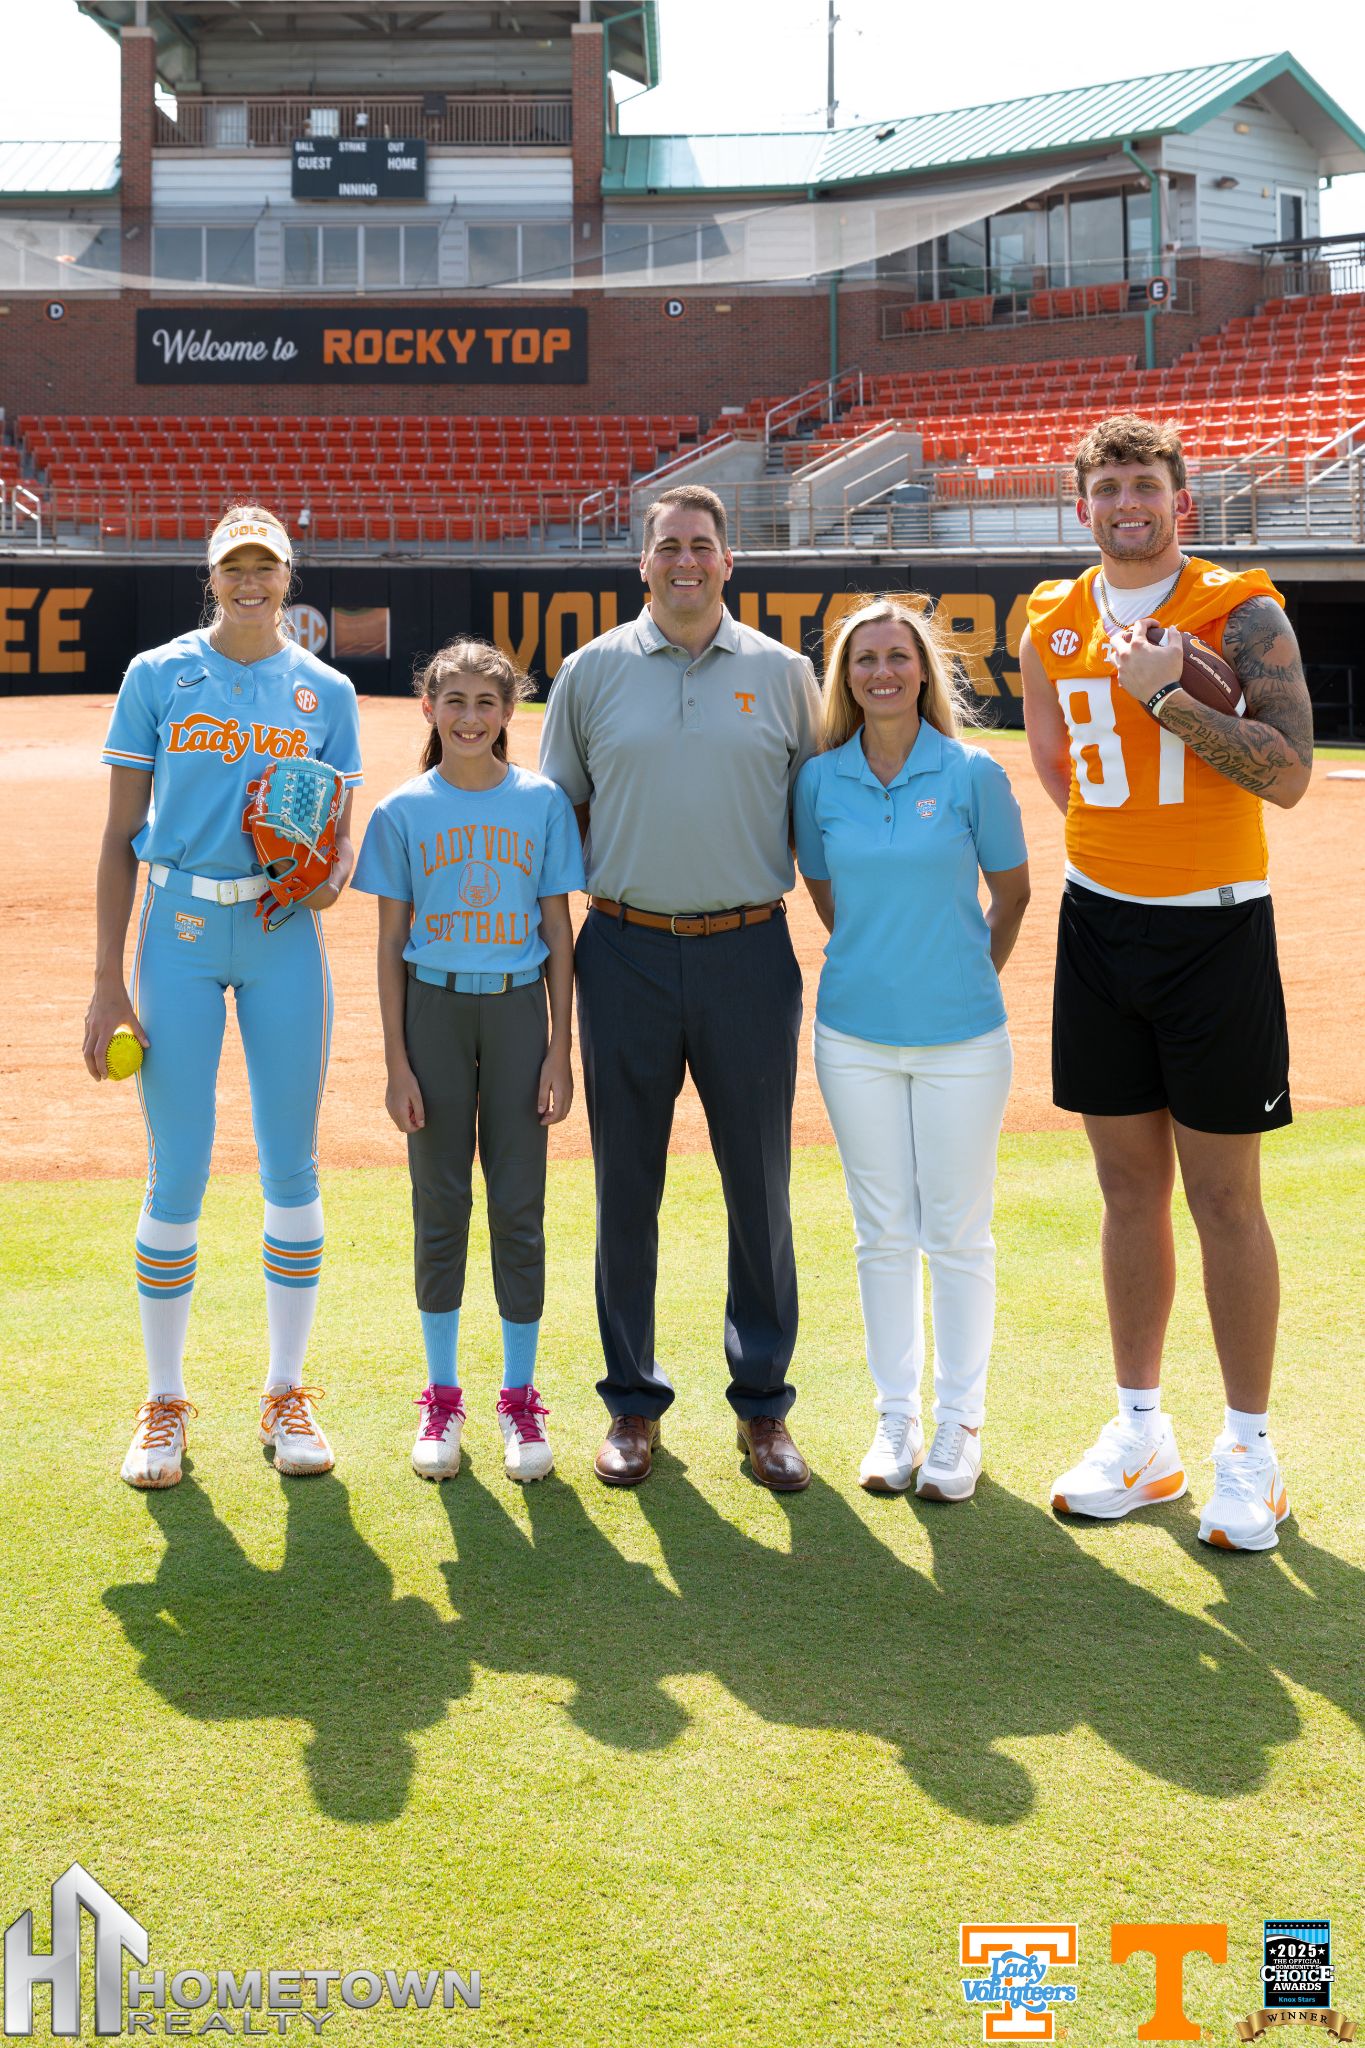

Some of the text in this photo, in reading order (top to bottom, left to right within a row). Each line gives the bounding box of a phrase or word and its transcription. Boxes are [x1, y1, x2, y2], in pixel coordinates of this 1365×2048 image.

[295, 141, 405, 153] BALL STRIKE OUT
[297, 156, 332, 170] GUEST
[387, 157, 418, 170] HOME
[338, 183, 378, 196] INNING
[1153, 282, 1164, 299] E
[50, 303, 65, 320] D
[669, 301, 683, 316] D
[152, 328, 571, 364] Welcome to ROCKY TOP
[229, 524, 268, 538] VOLS
[1050, 629, 1080, 656] SEC
[297, 687, 317, 711] SEC
[735, 691, 756, 713] T
[166, 712, 310, 764] Lady Vols
[419, 824, 535, 877] LADY VOLS
